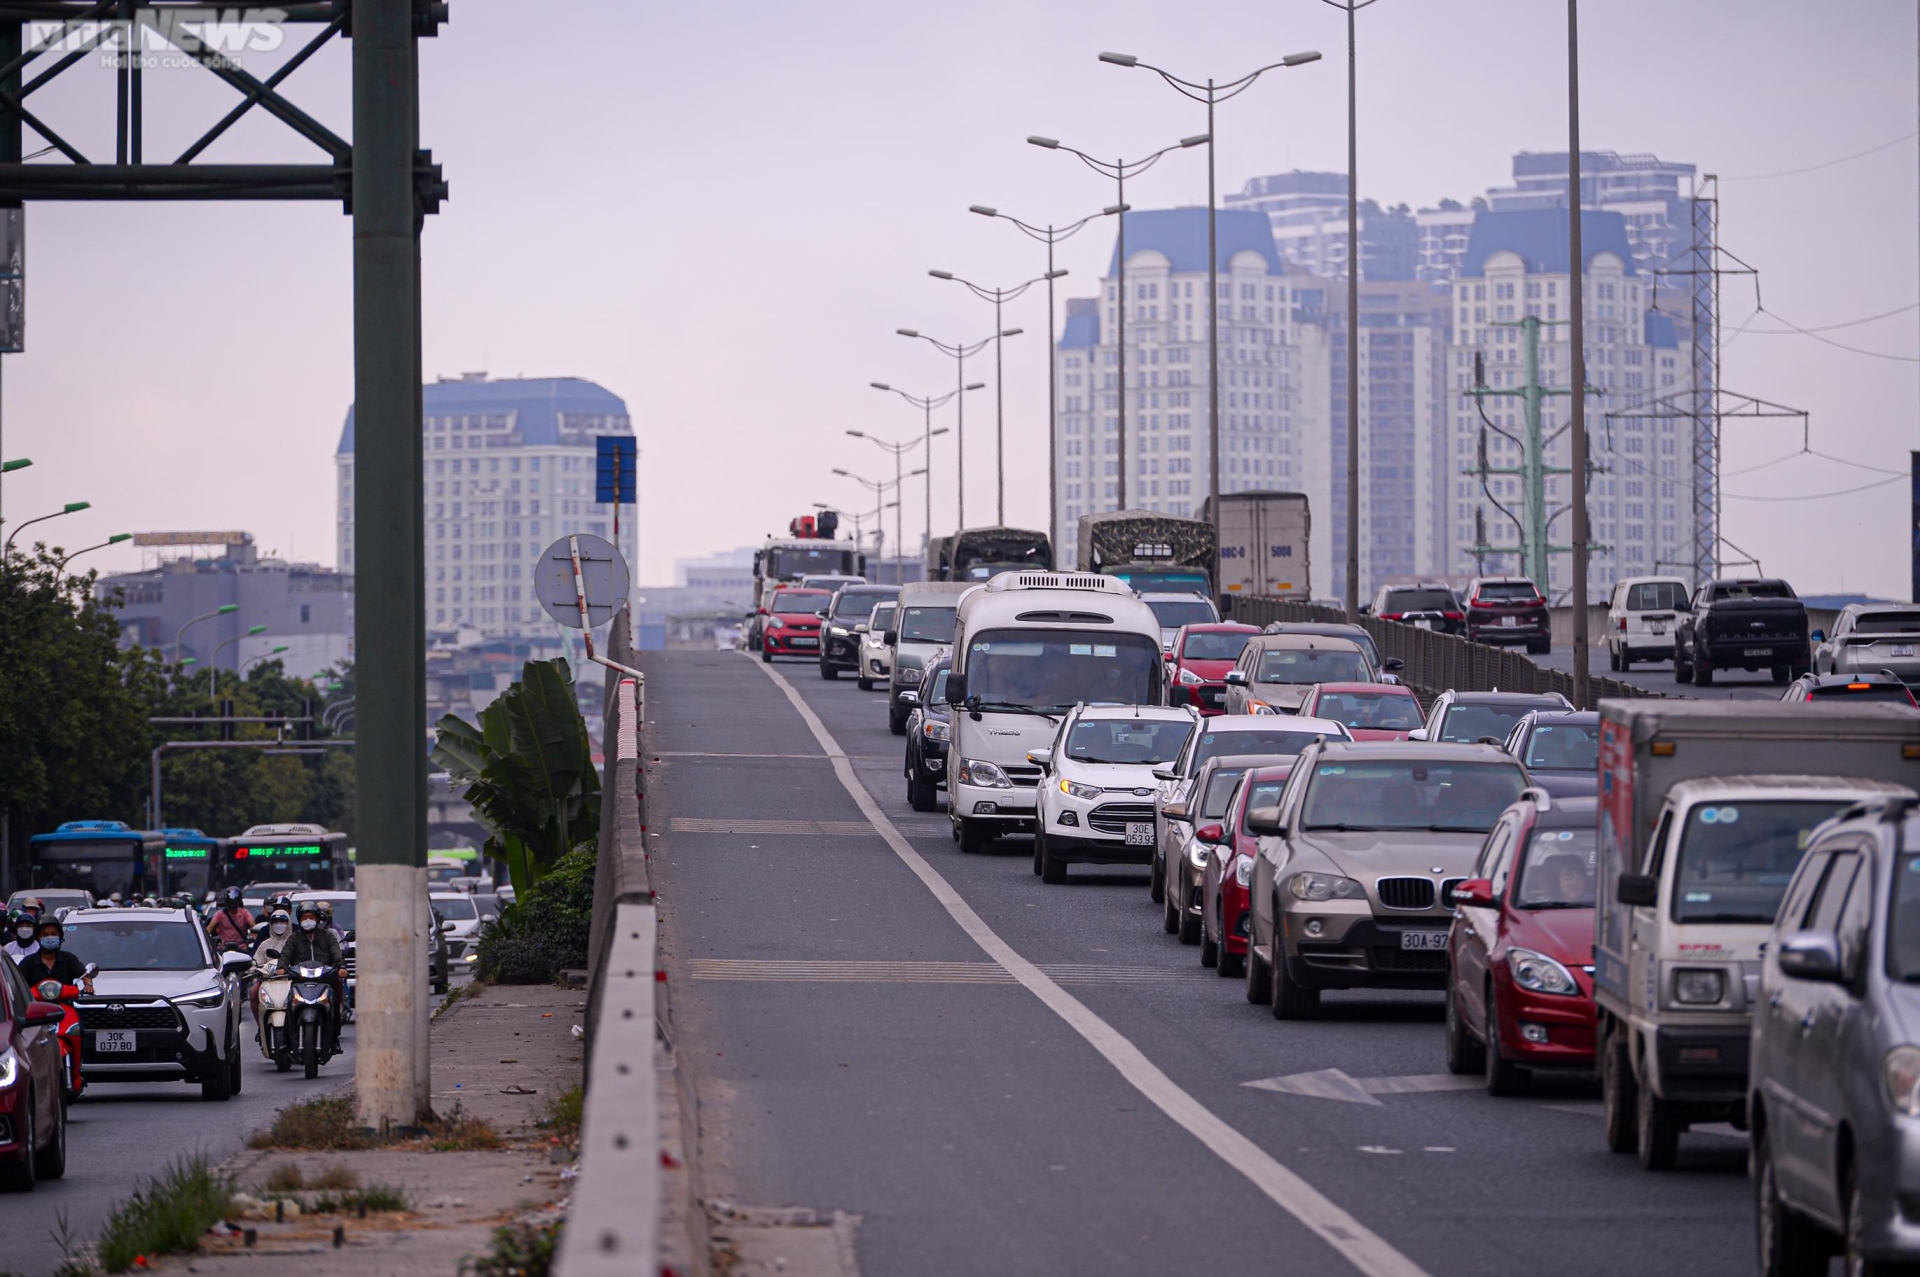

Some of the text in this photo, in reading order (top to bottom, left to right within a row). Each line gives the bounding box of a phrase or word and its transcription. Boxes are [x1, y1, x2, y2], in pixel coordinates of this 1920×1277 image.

[1133, 824, 1150, 834] 30E
[107, 1032, 124, 1041] 30K
[100, 1041, 132, 1051] 037.80
